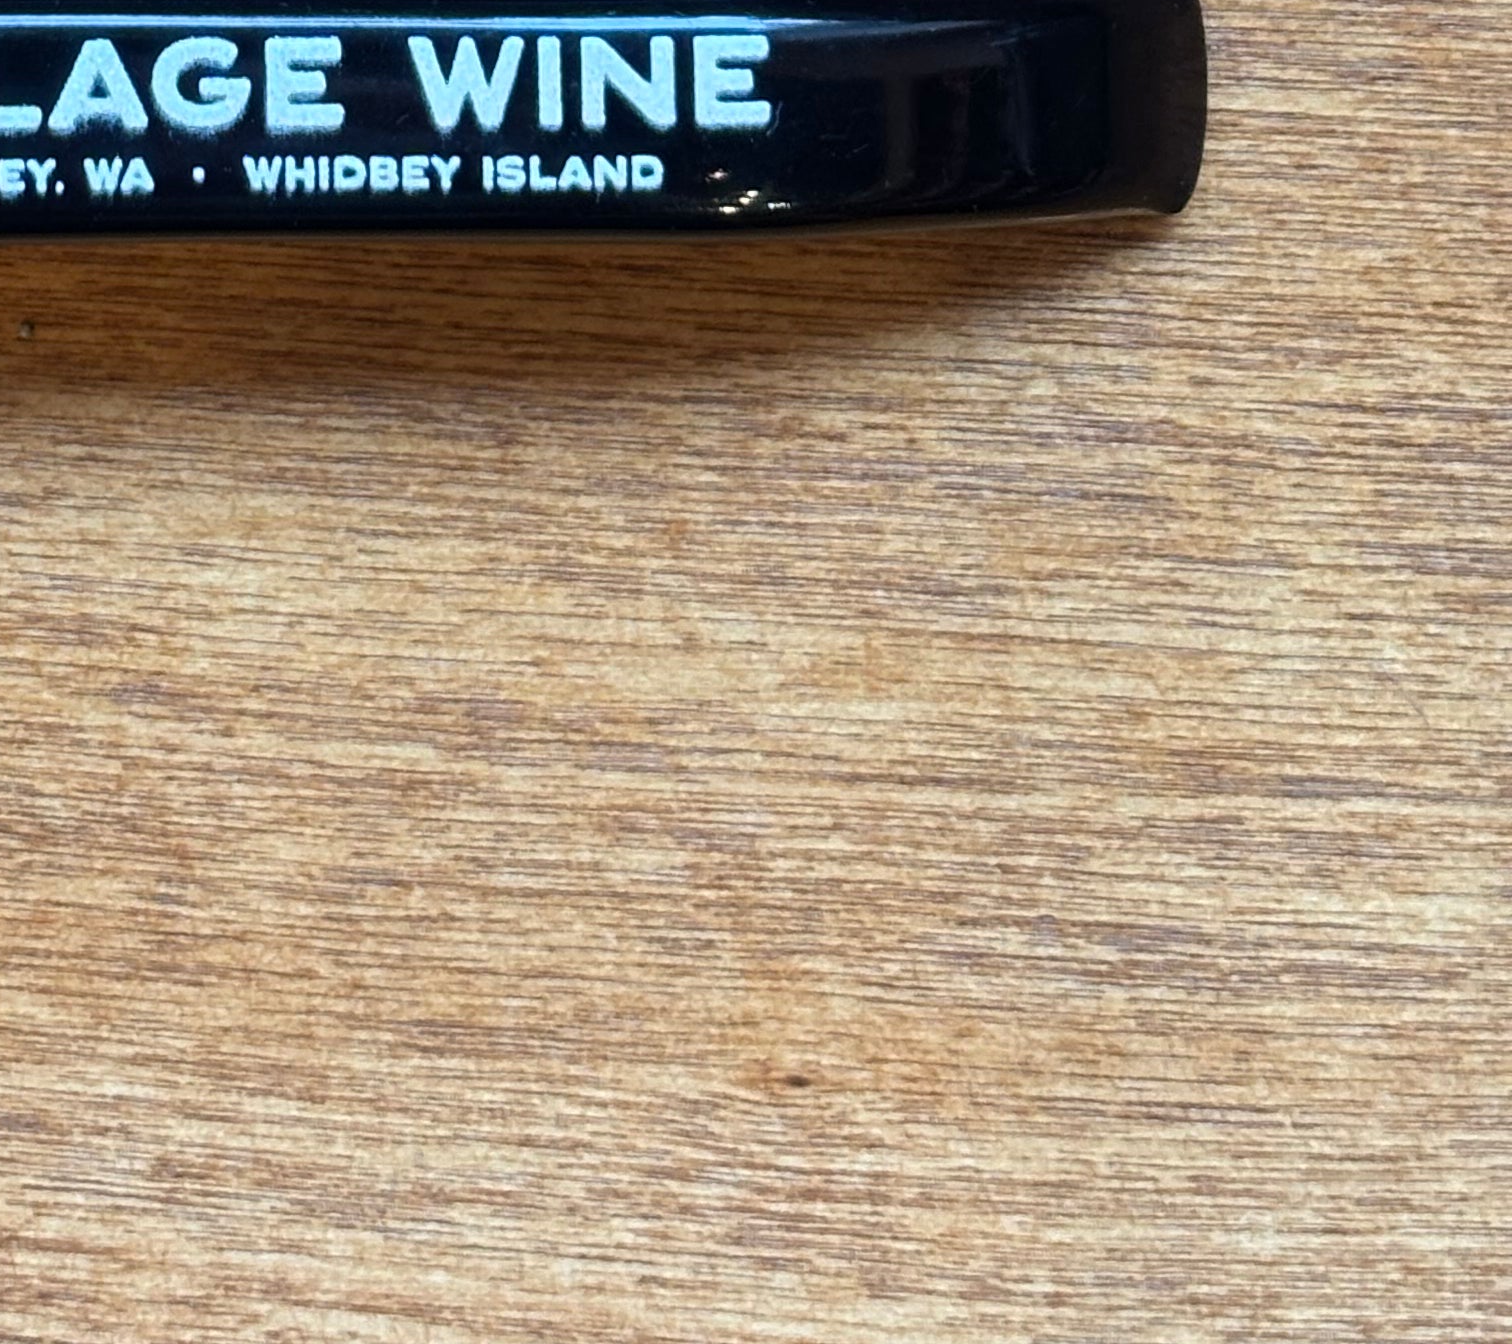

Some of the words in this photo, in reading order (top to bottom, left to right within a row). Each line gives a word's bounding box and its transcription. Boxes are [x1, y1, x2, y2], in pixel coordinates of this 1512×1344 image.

[407, 33, 772, 132] WINE
[84, 156, 154, 196] WA
[243, 155, 461, 195] WHIDBEY
[482, 155, 664, 192] ISLAND
